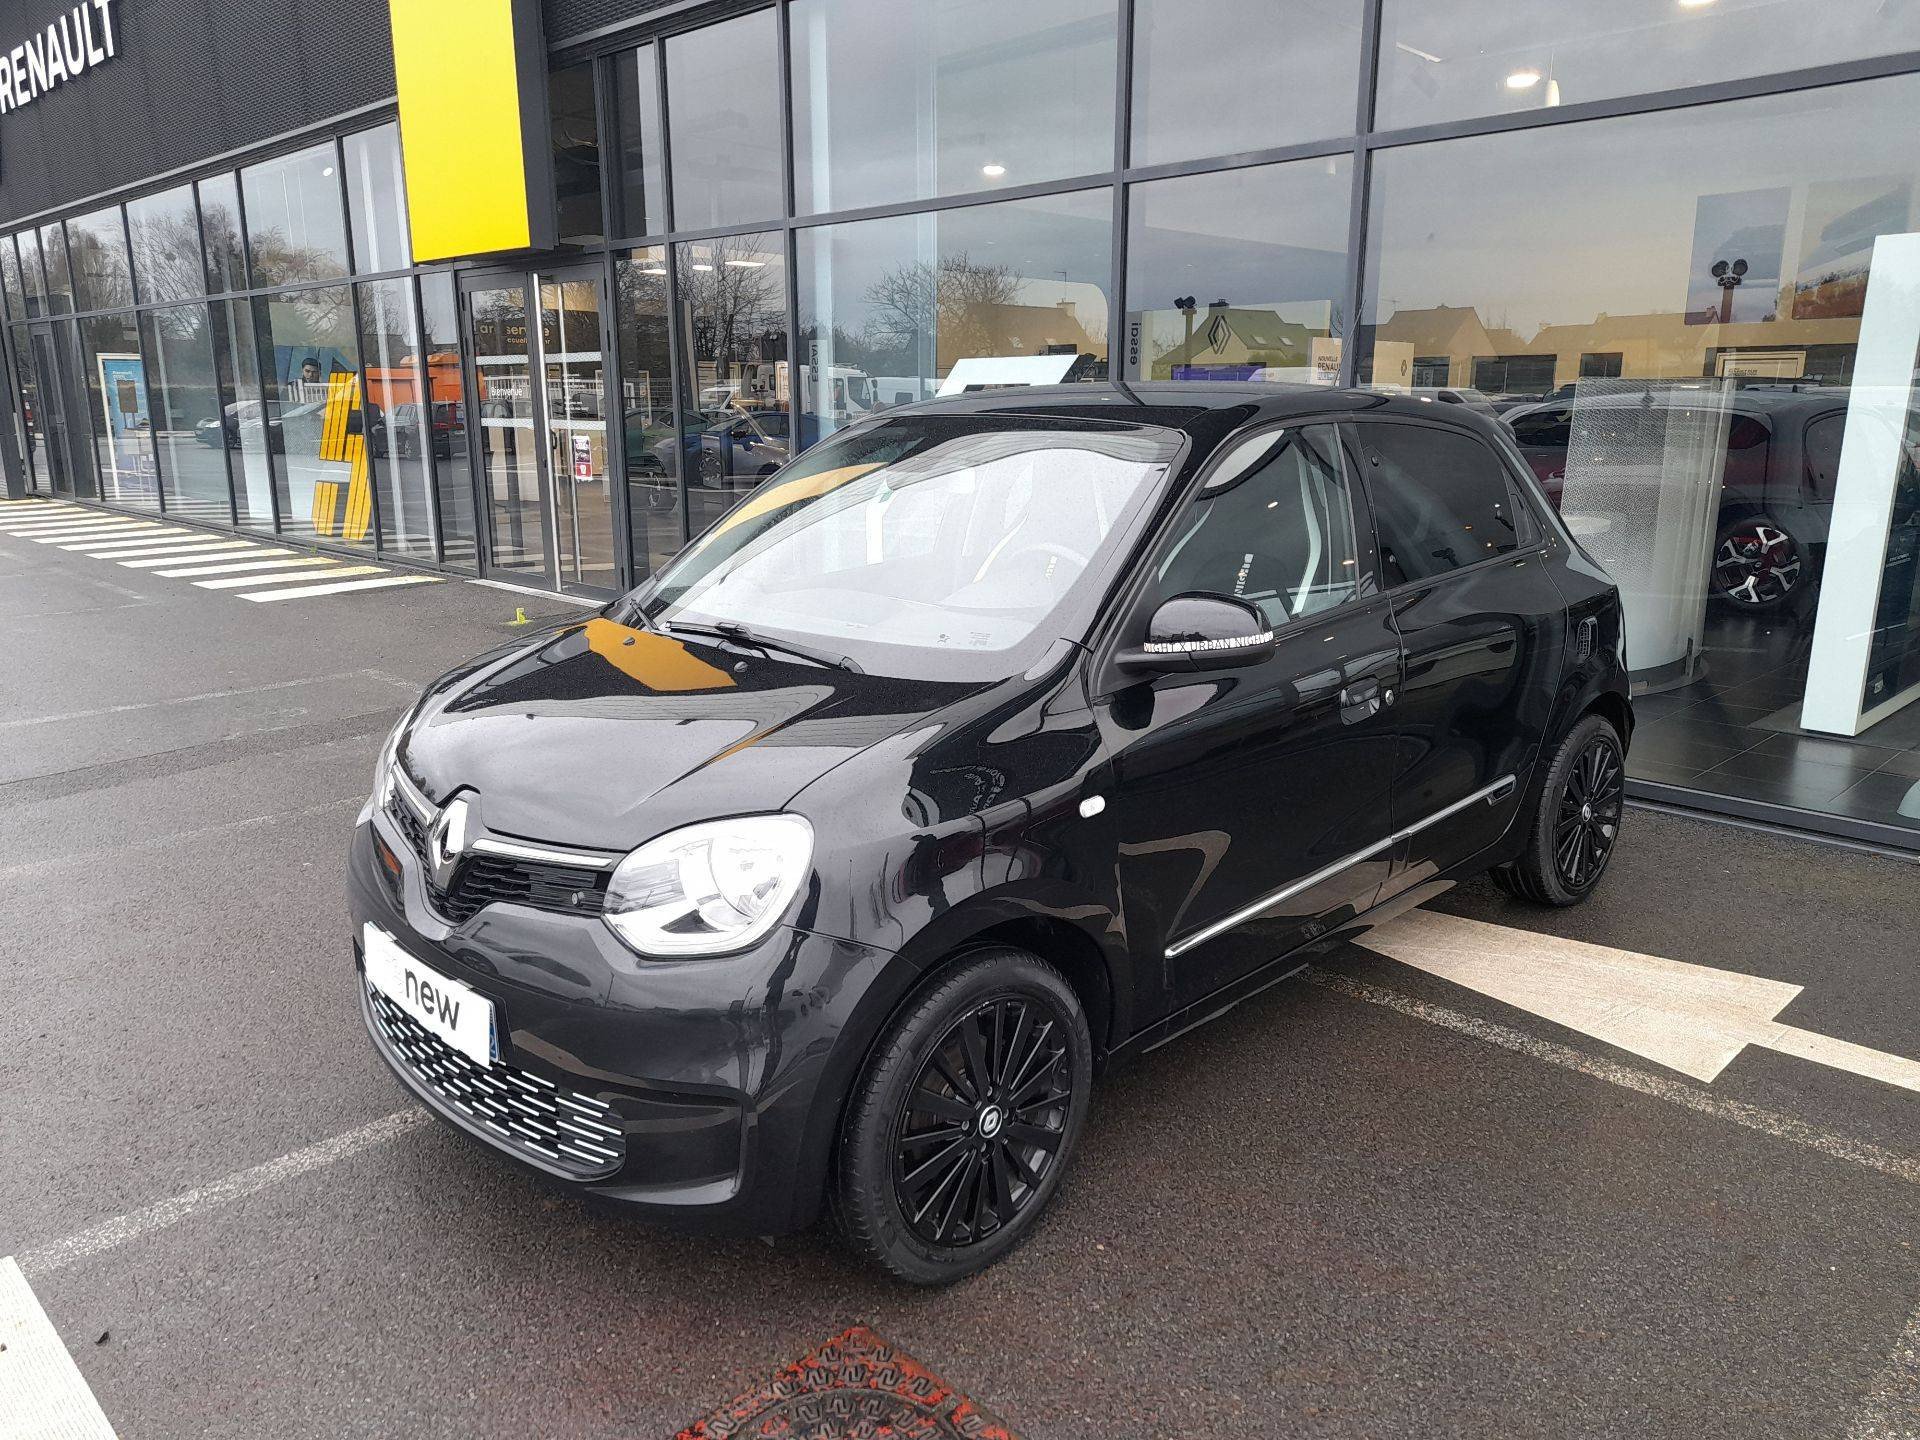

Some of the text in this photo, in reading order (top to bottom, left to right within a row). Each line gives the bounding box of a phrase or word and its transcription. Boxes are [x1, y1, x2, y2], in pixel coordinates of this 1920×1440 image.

[0, 0, 115, 115] RENAULT
[491, 387, 523, 396] Bienvenue
[405, 968, 460, 1031] new
